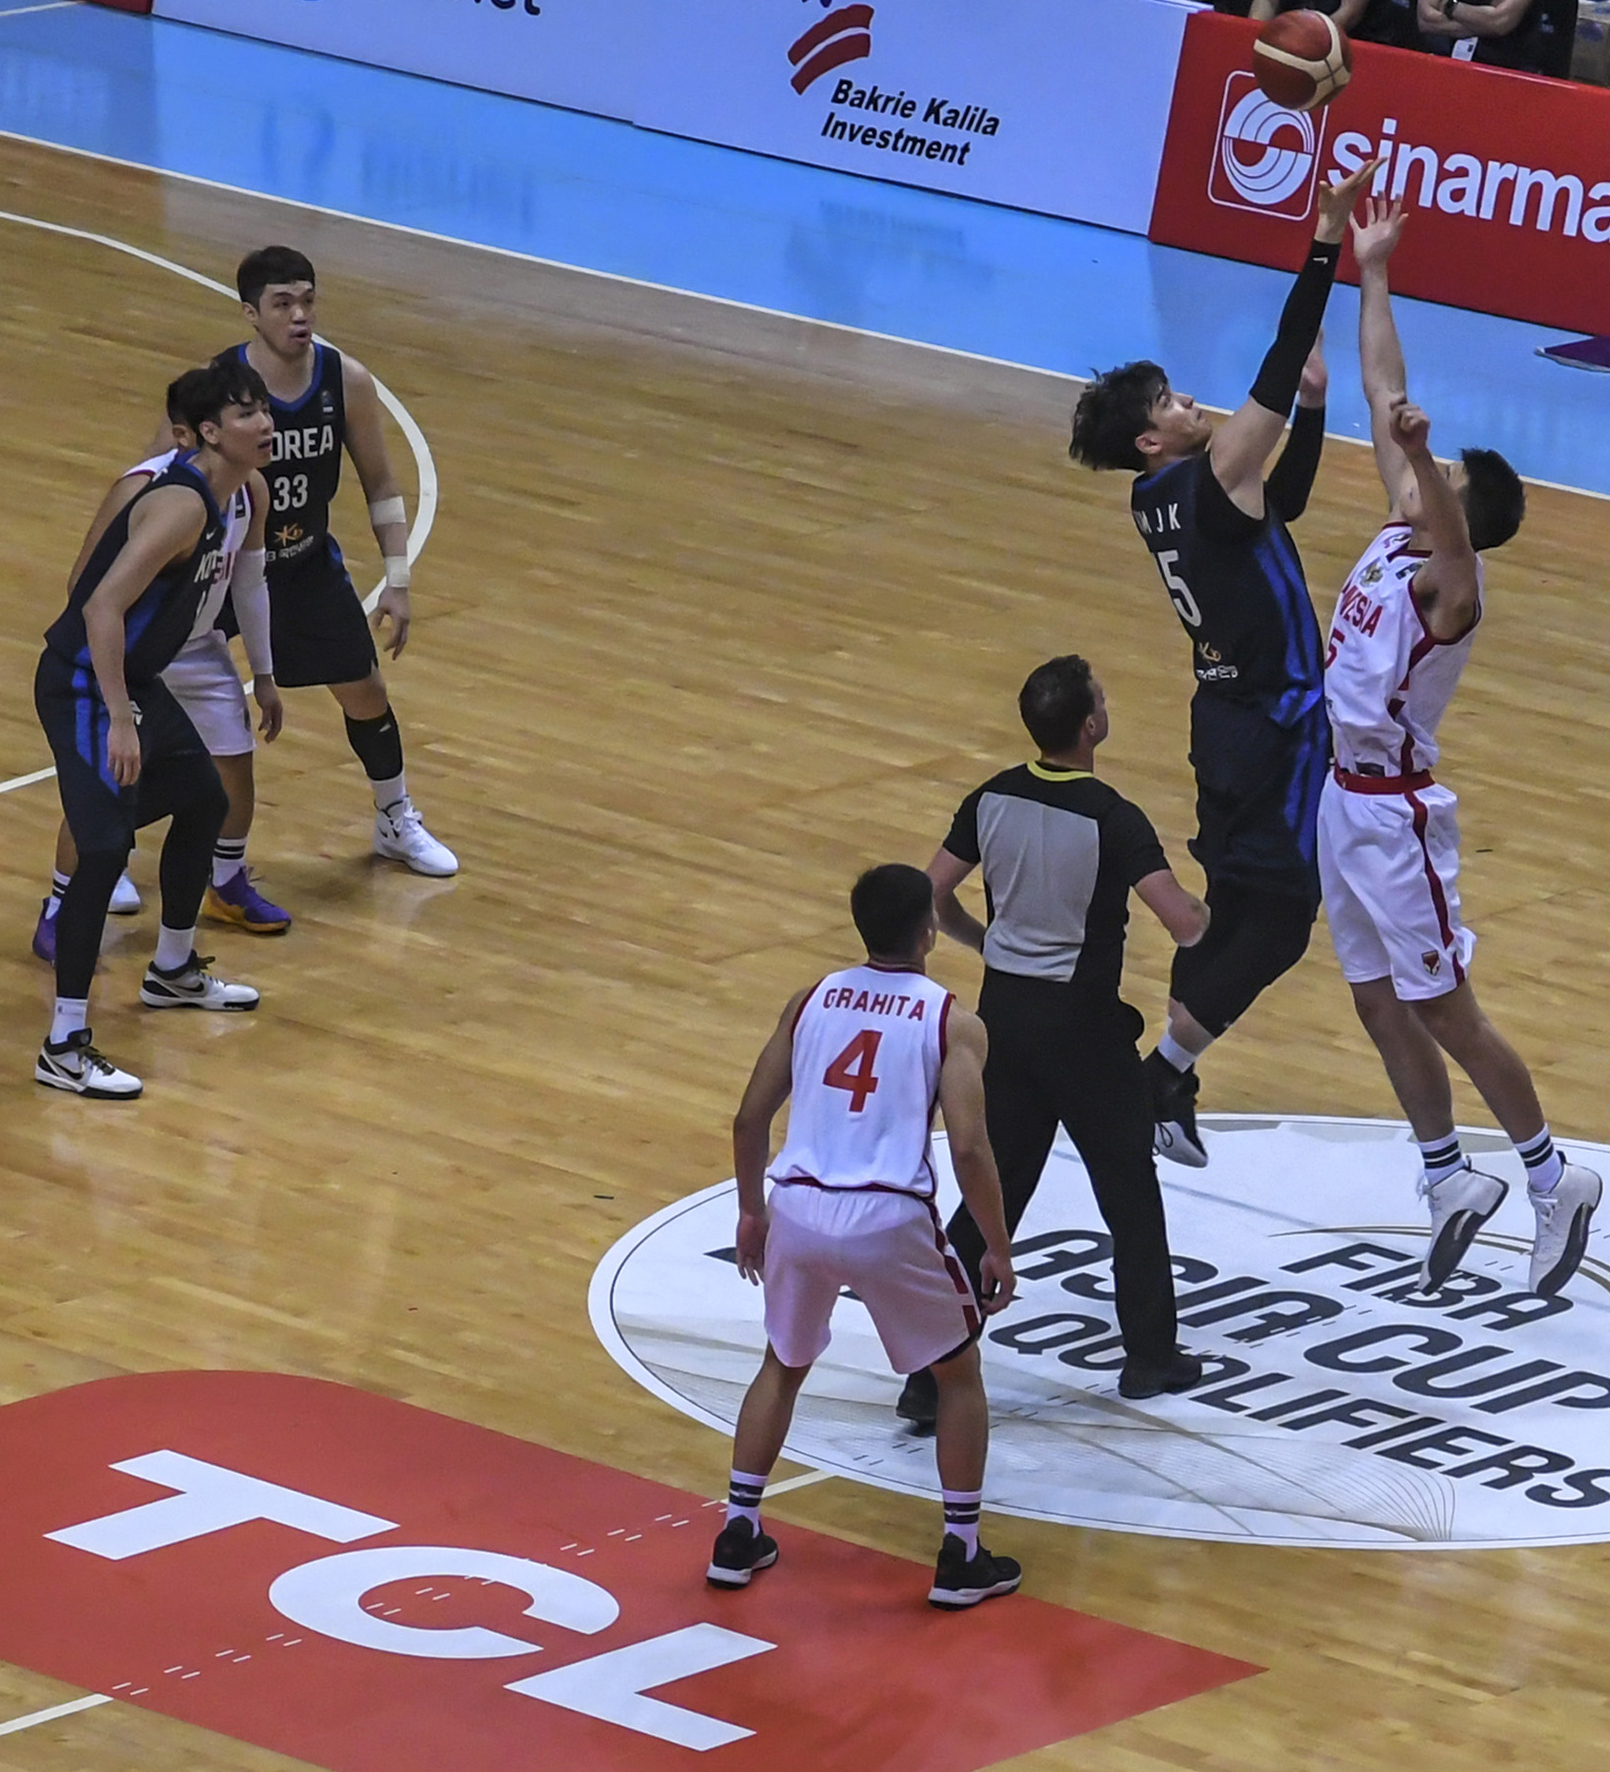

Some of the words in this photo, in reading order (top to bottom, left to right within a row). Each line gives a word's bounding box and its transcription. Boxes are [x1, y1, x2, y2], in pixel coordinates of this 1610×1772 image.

[831, 79, 917, 118] Bakrie
[922, 97, 1000, 136] Kalila
[821, 112, 970, 166] Investment
[271, 424, 334, 462] OREA
[273, 473, 308, 512] 33
[1155, 507, 1164, 533] J
[1168, 502, 1182, 530] K
[822, 987, 926, 1021] GRAHITA
[822, 1029, 883, 1113] 4
[1010, 1229, 1346, 1346] ASIA
[1279, 1243, 1574, 1331] FIBA
[43, 1448, 778, 1752] TCL
